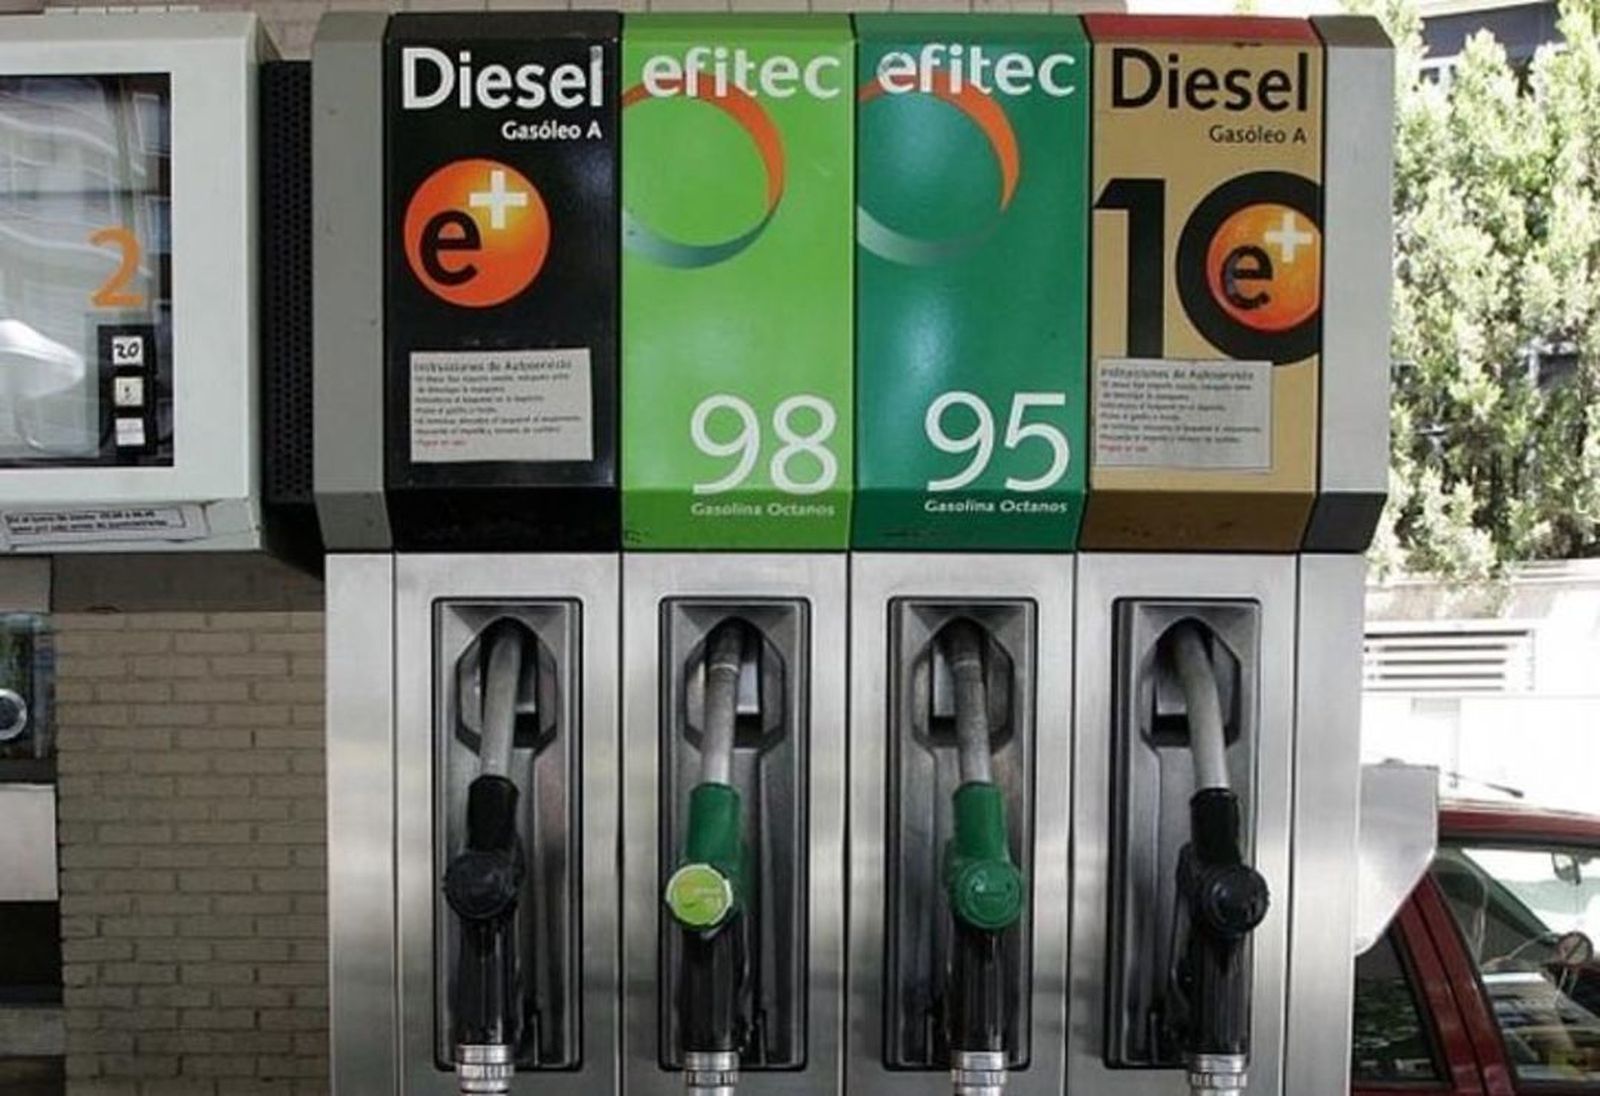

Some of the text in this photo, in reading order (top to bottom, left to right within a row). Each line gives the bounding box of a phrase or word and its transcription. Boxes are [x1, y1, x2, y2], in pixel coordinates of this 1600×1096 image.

[402, 45, 604, 110] Diesel
[641, 46, 841, 100] efitec
[876, 42, 1076, 97] efitec
[1110, 46, 1309, 113] Diesel
[501, 118, 603, 141] Gasóleo A
[1208, 124, 1308, 145] Gasóleo A
[89, 225, 143, 308] 2
[115, 341, 140, 359] 20
[690, 393, 839, 496] 98
[924, 390, 1071, 492] 95
[690, 502, 836, 517] Gasolina Octanos
[924, 499, 1068, 513] Gasolina Octanos
